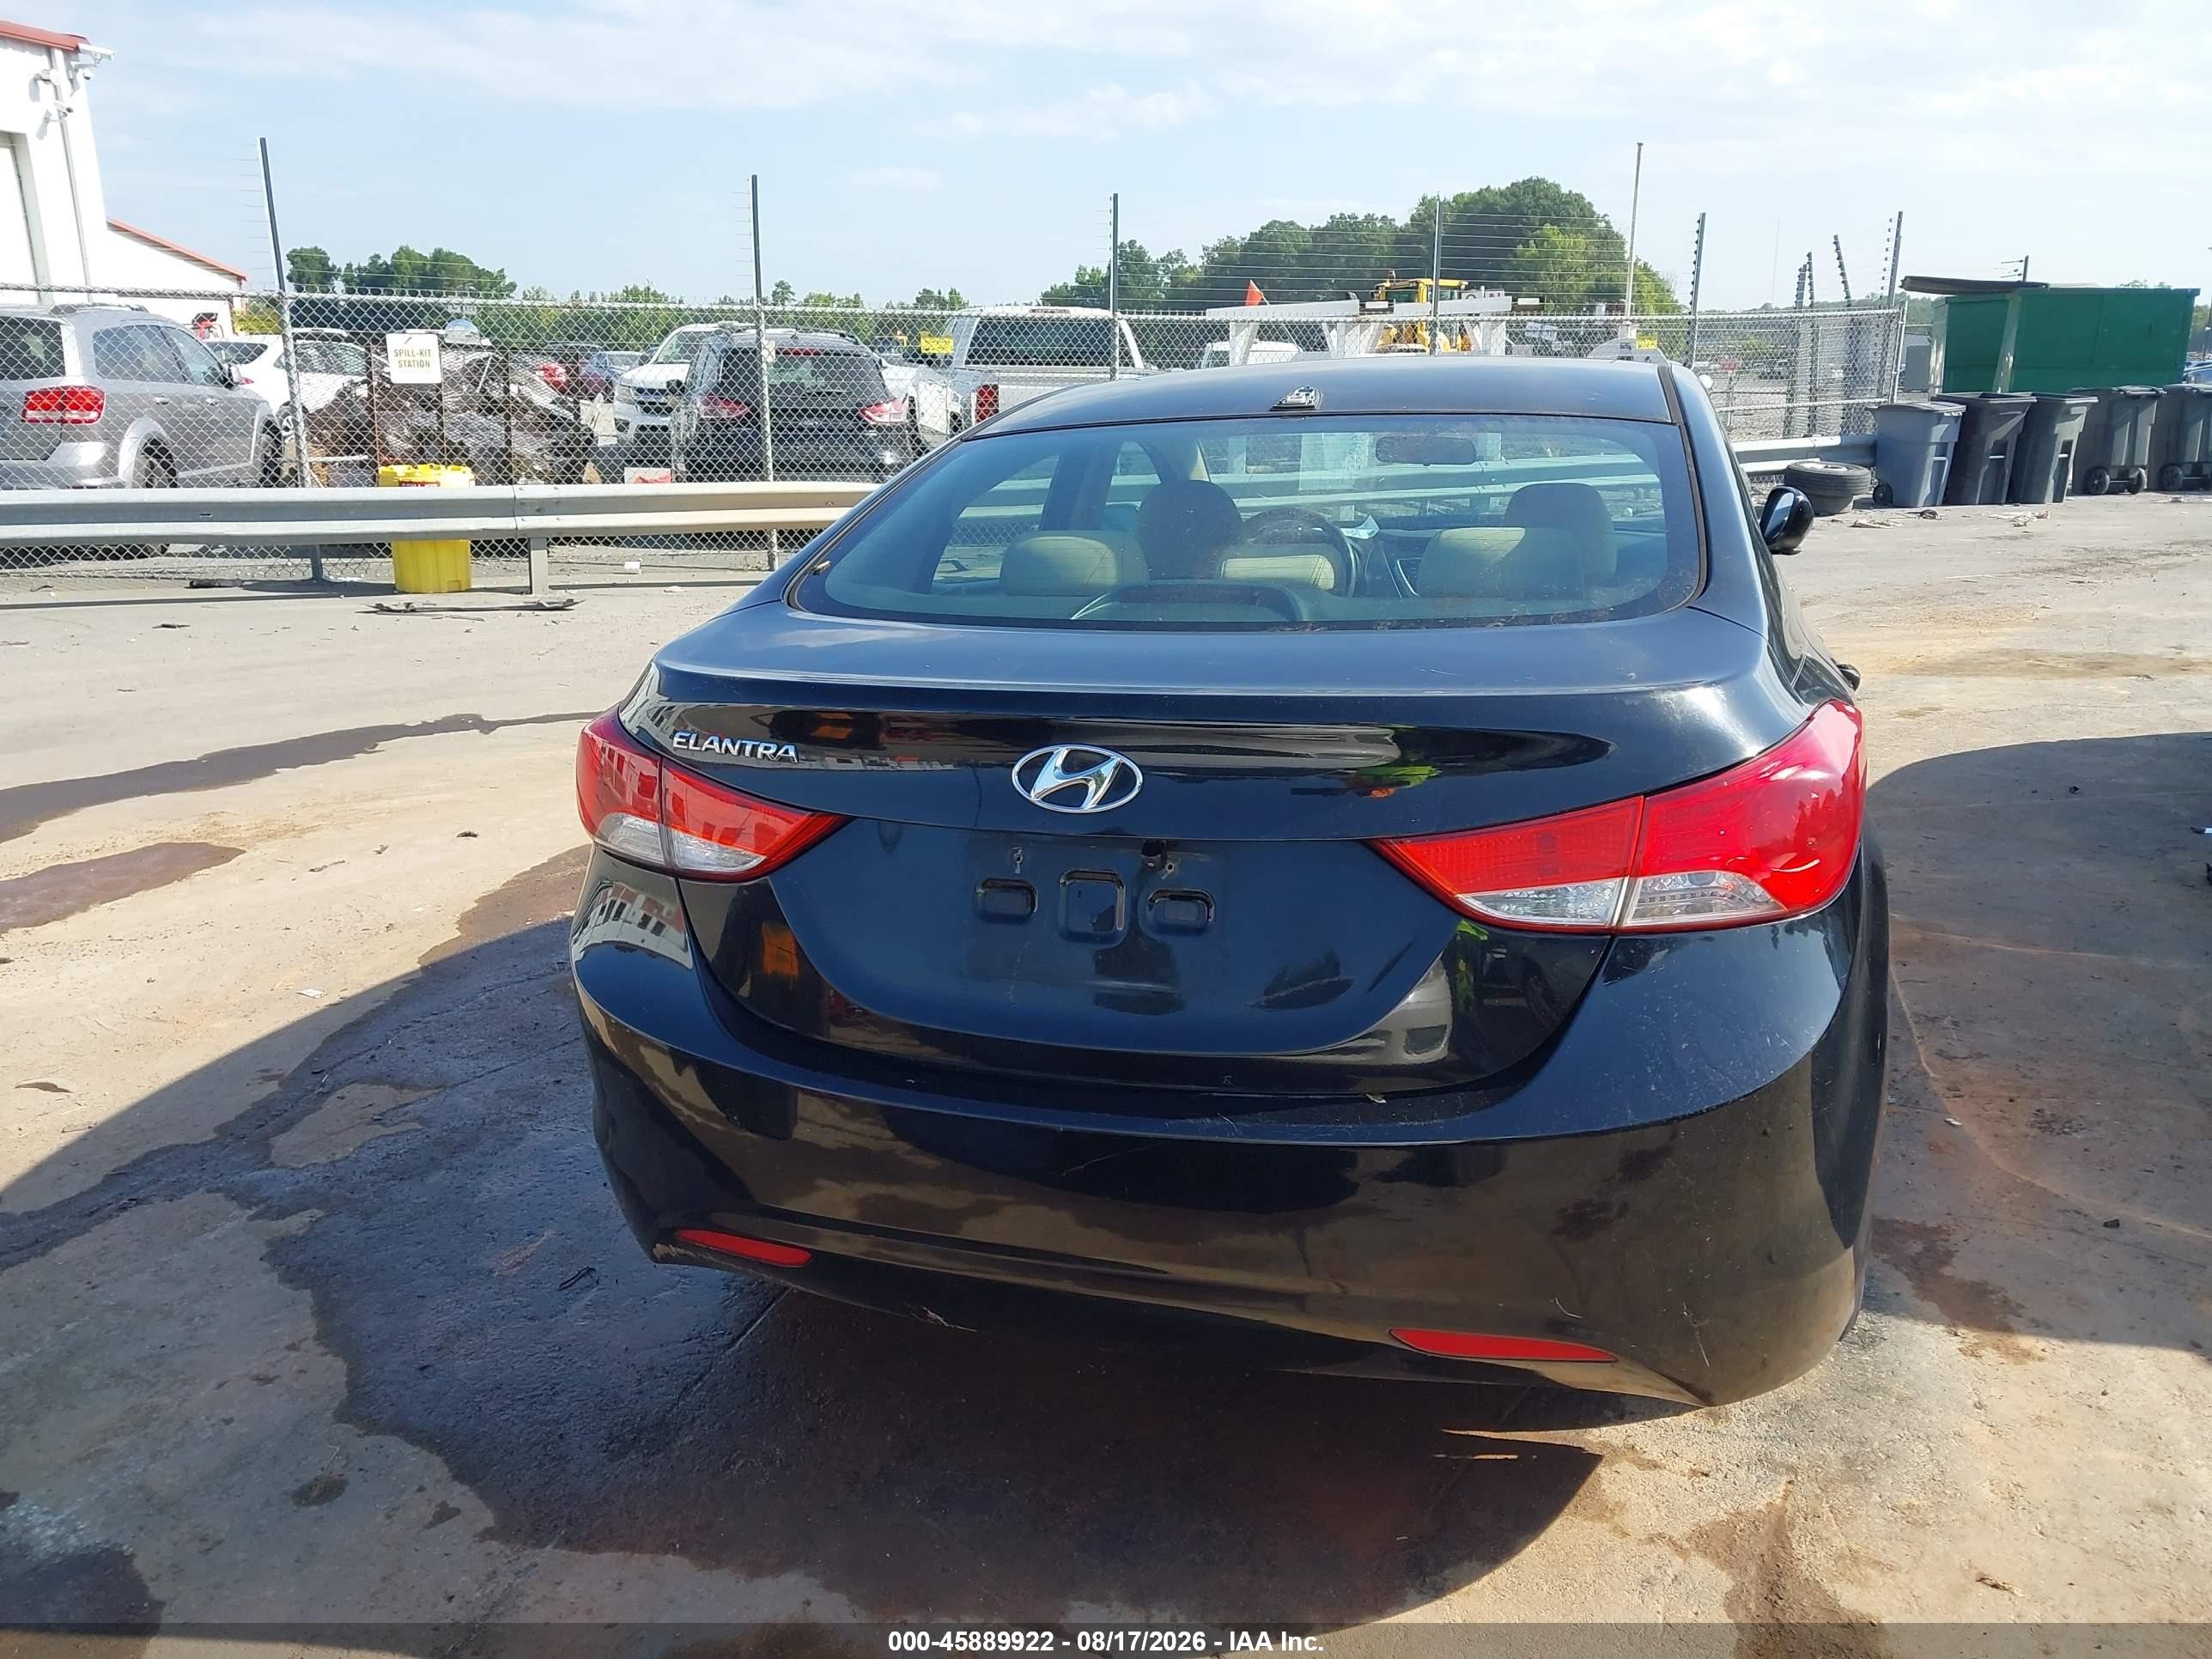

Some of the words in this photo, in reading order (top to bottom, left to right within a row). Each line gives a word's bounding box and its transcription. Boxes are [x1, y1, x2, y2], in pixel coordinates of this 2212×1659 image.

[394, 349, 431, 357] SPILL-KIT
[398, 360, 430, 368] STATION
[672, 732, 799, 763] ELANTRA
